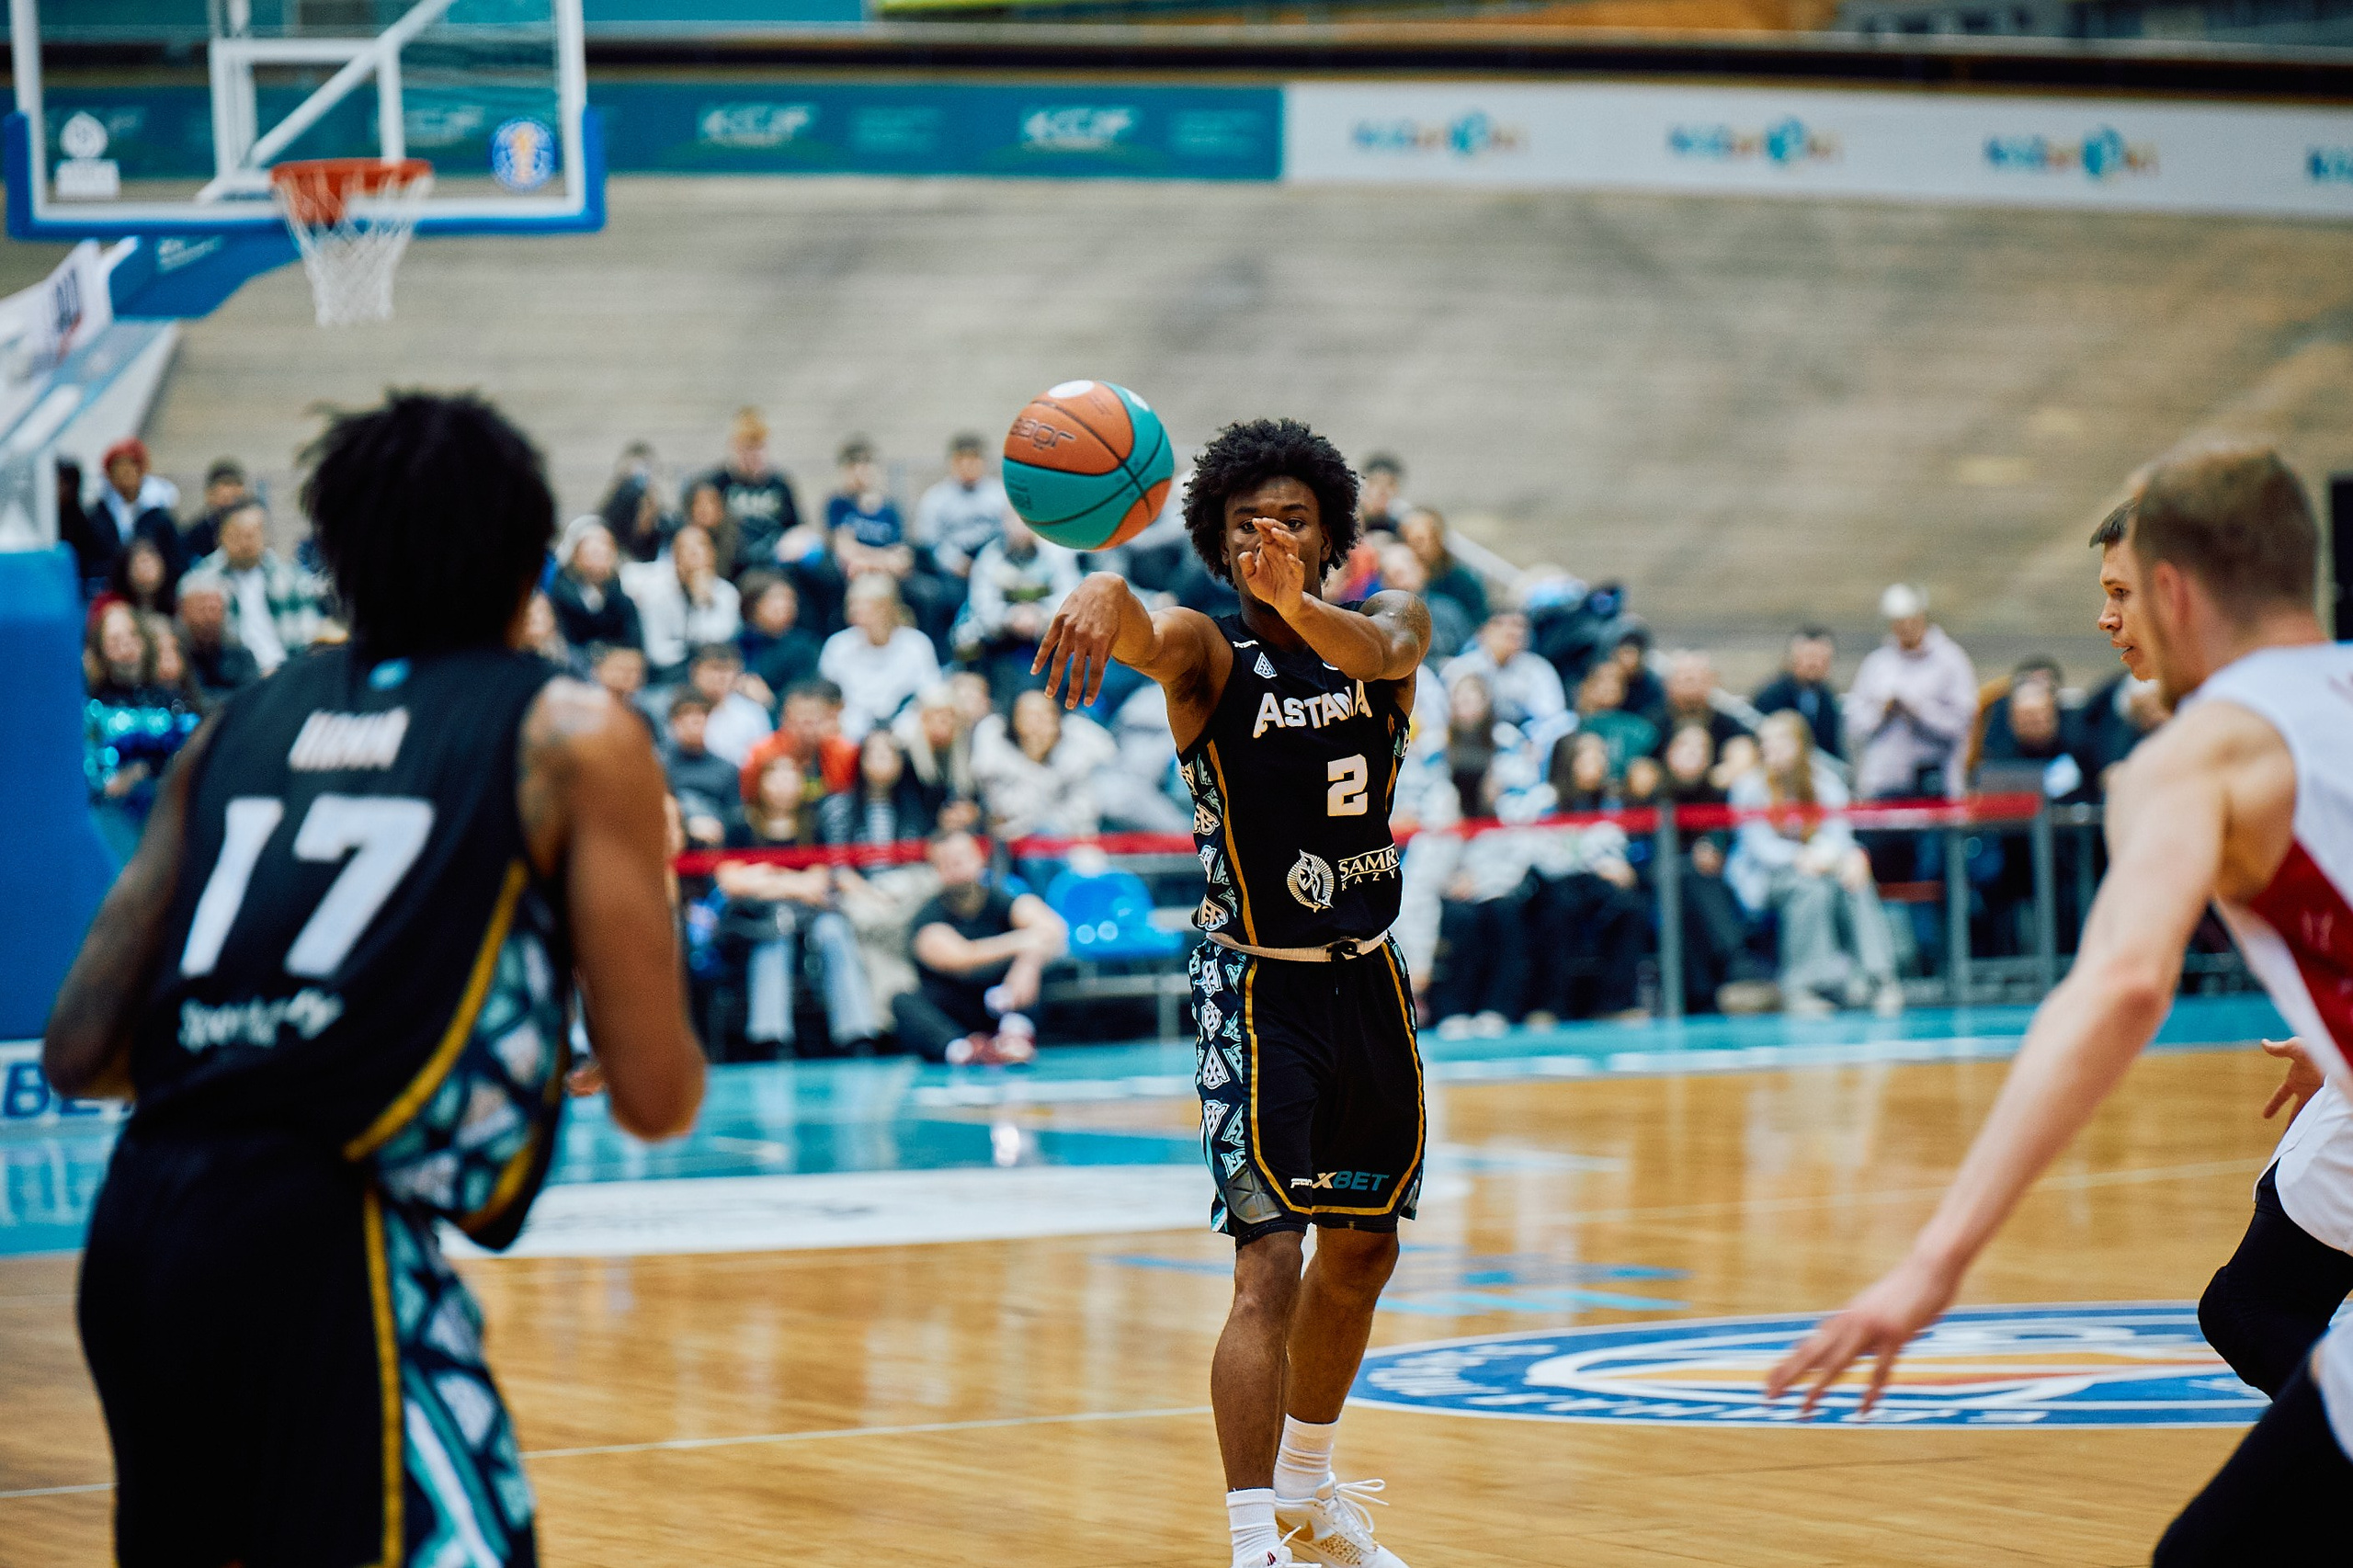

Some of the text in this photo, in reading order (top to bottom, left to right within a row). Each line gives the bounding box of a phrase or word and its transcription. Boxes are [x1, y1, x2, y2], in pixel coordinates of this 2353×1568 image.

[1327, 754, 1368, 816] 2
[179, 793, 436, 978] 17
[1338, 847, 1398, 880] SAMR
